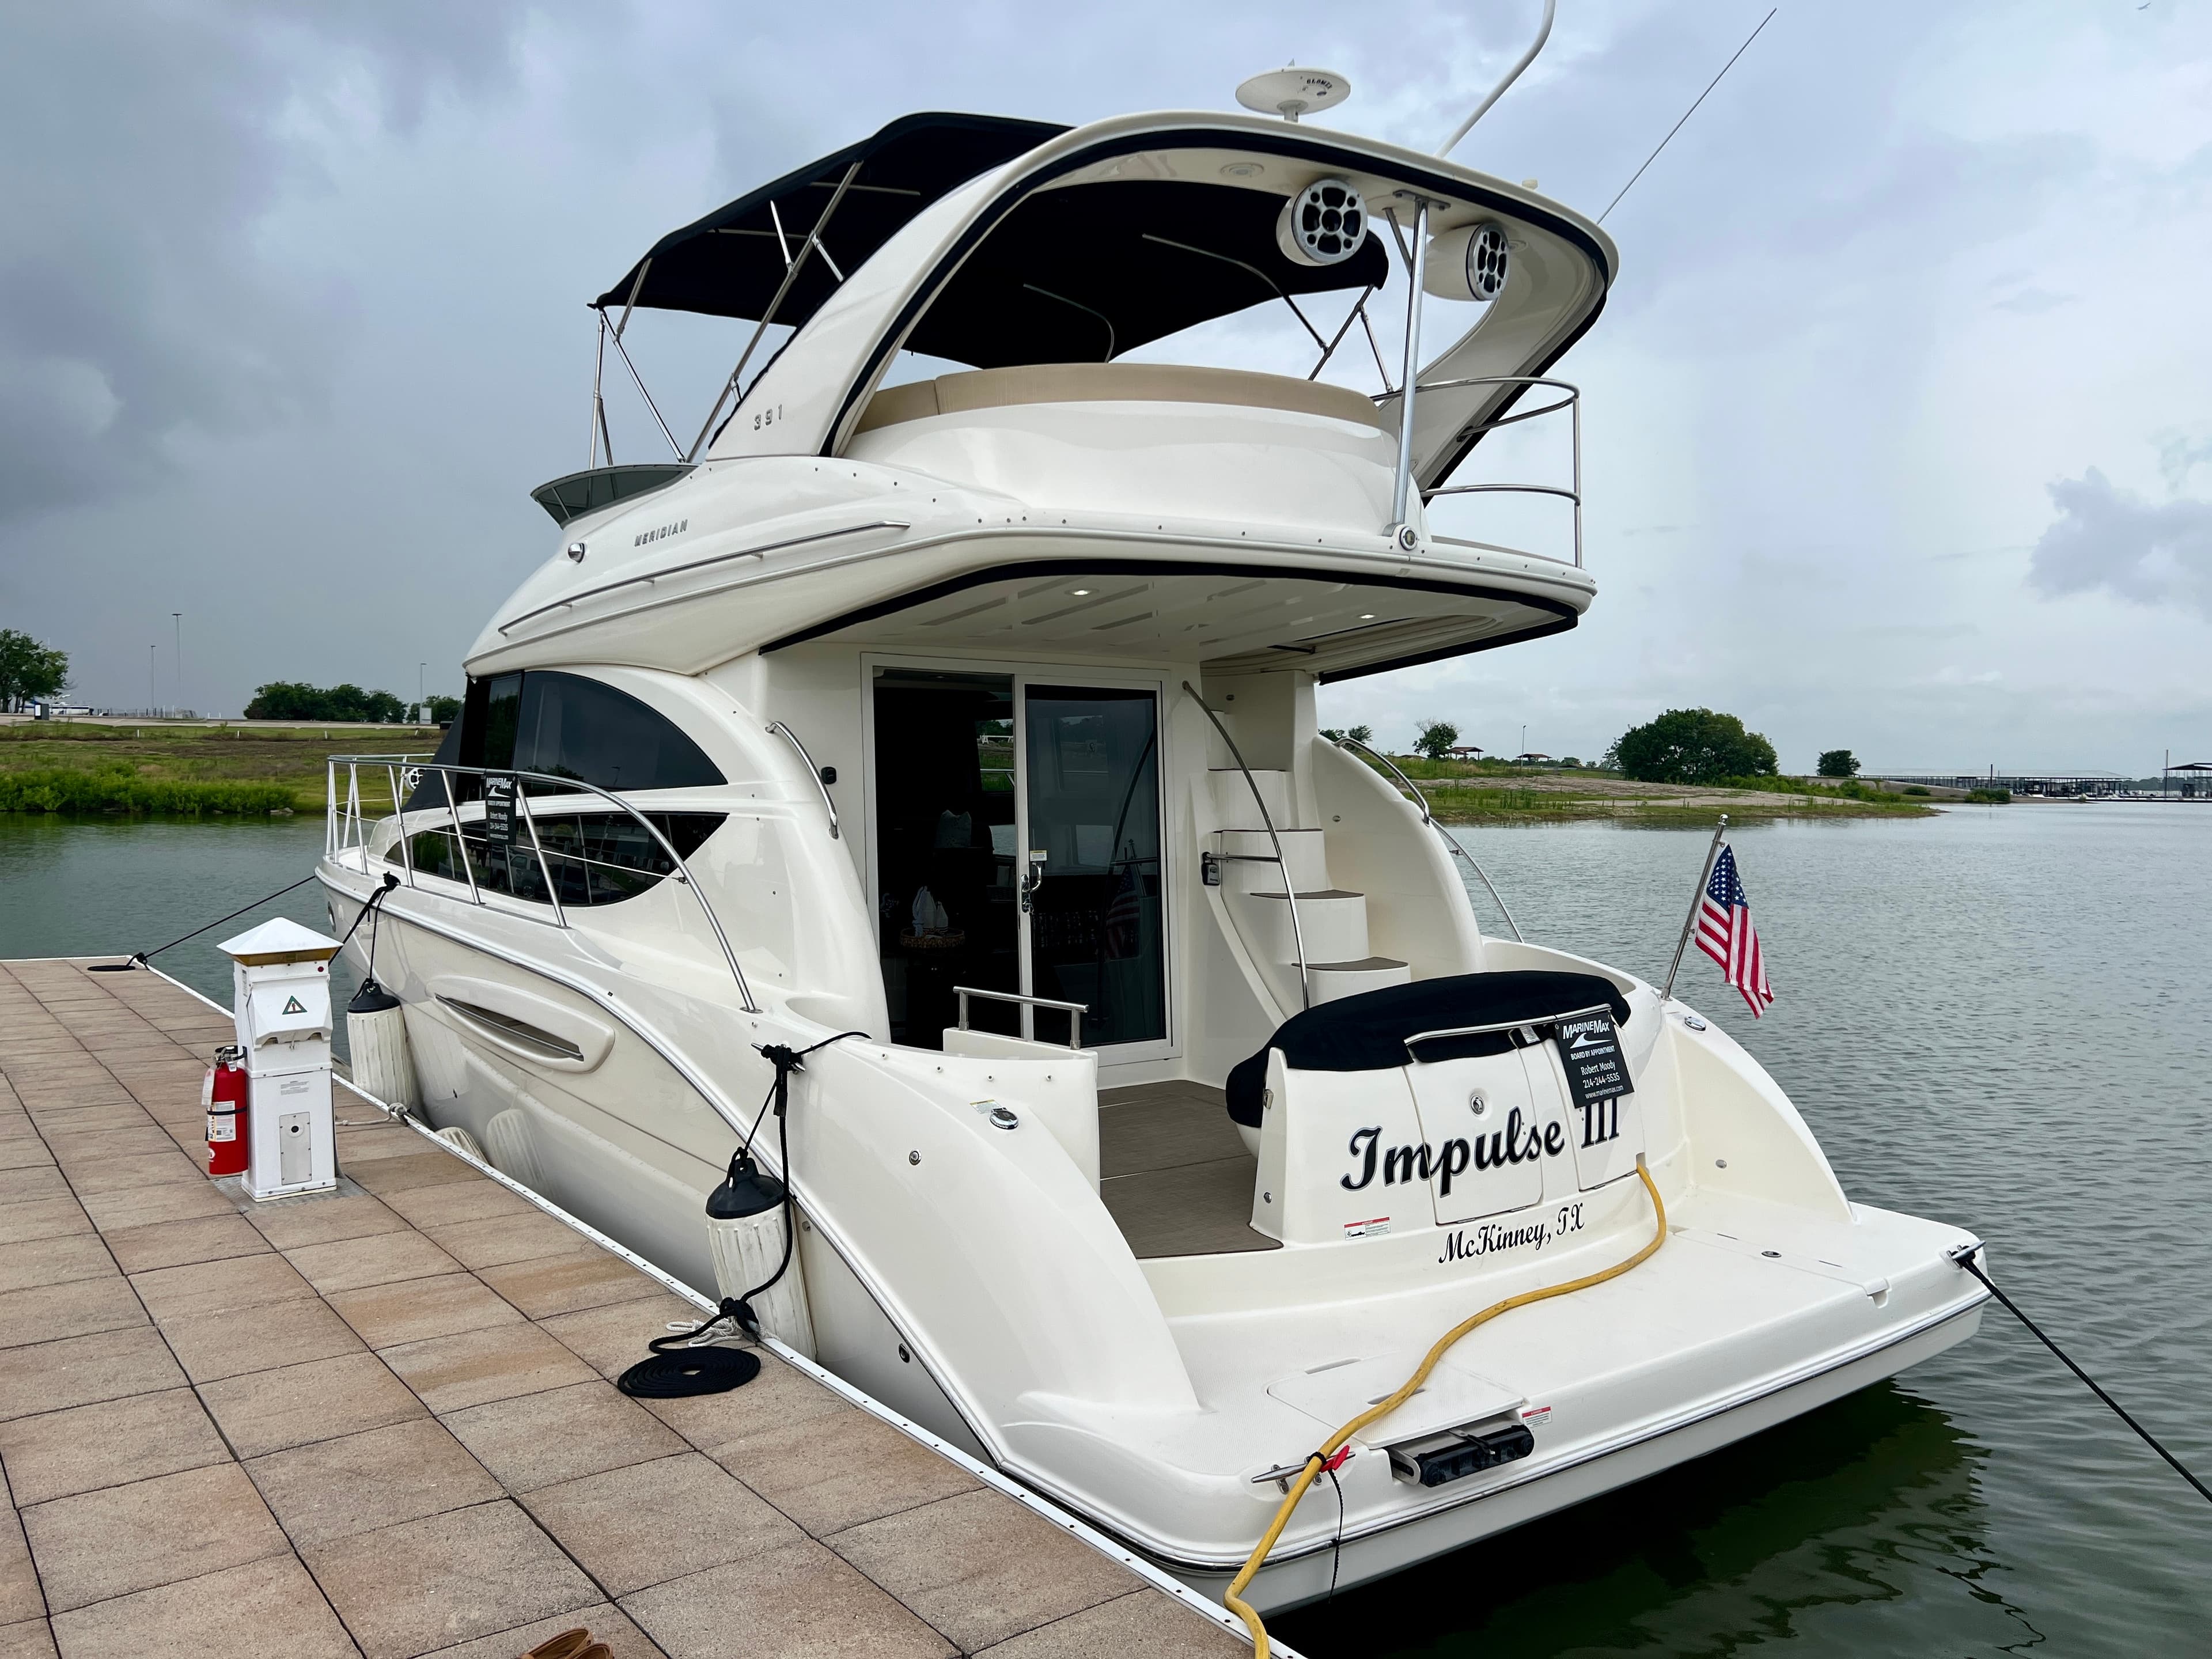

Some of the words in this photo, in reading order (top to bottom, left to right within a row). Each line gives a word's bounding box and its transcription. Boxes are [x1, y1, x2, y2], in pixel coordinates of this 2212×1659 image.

[753, 404, 782, 431] 391
[634, 519, 688, 547] MERIDIAN
[1570, 1051, 1585, 1060] BOARD
[1590, 1045, 1615, 1056] APPOINTMENT
[1580, 1065, 1600, 1076] Robert
[1599, 1060, 1616, 1071] Moody
[1582, 1072, 1620, 1089] 214-244-5535
[1585, 1085, 1624, 1099] www.marinemax.com
[1340, 1106, 1565, 1198] Impulse
[1581, 1096, 1620, 1149] III
[1438, 1223, 1552, 1264] McKinney,
[1557, 1202, 1585, 1236] TX
